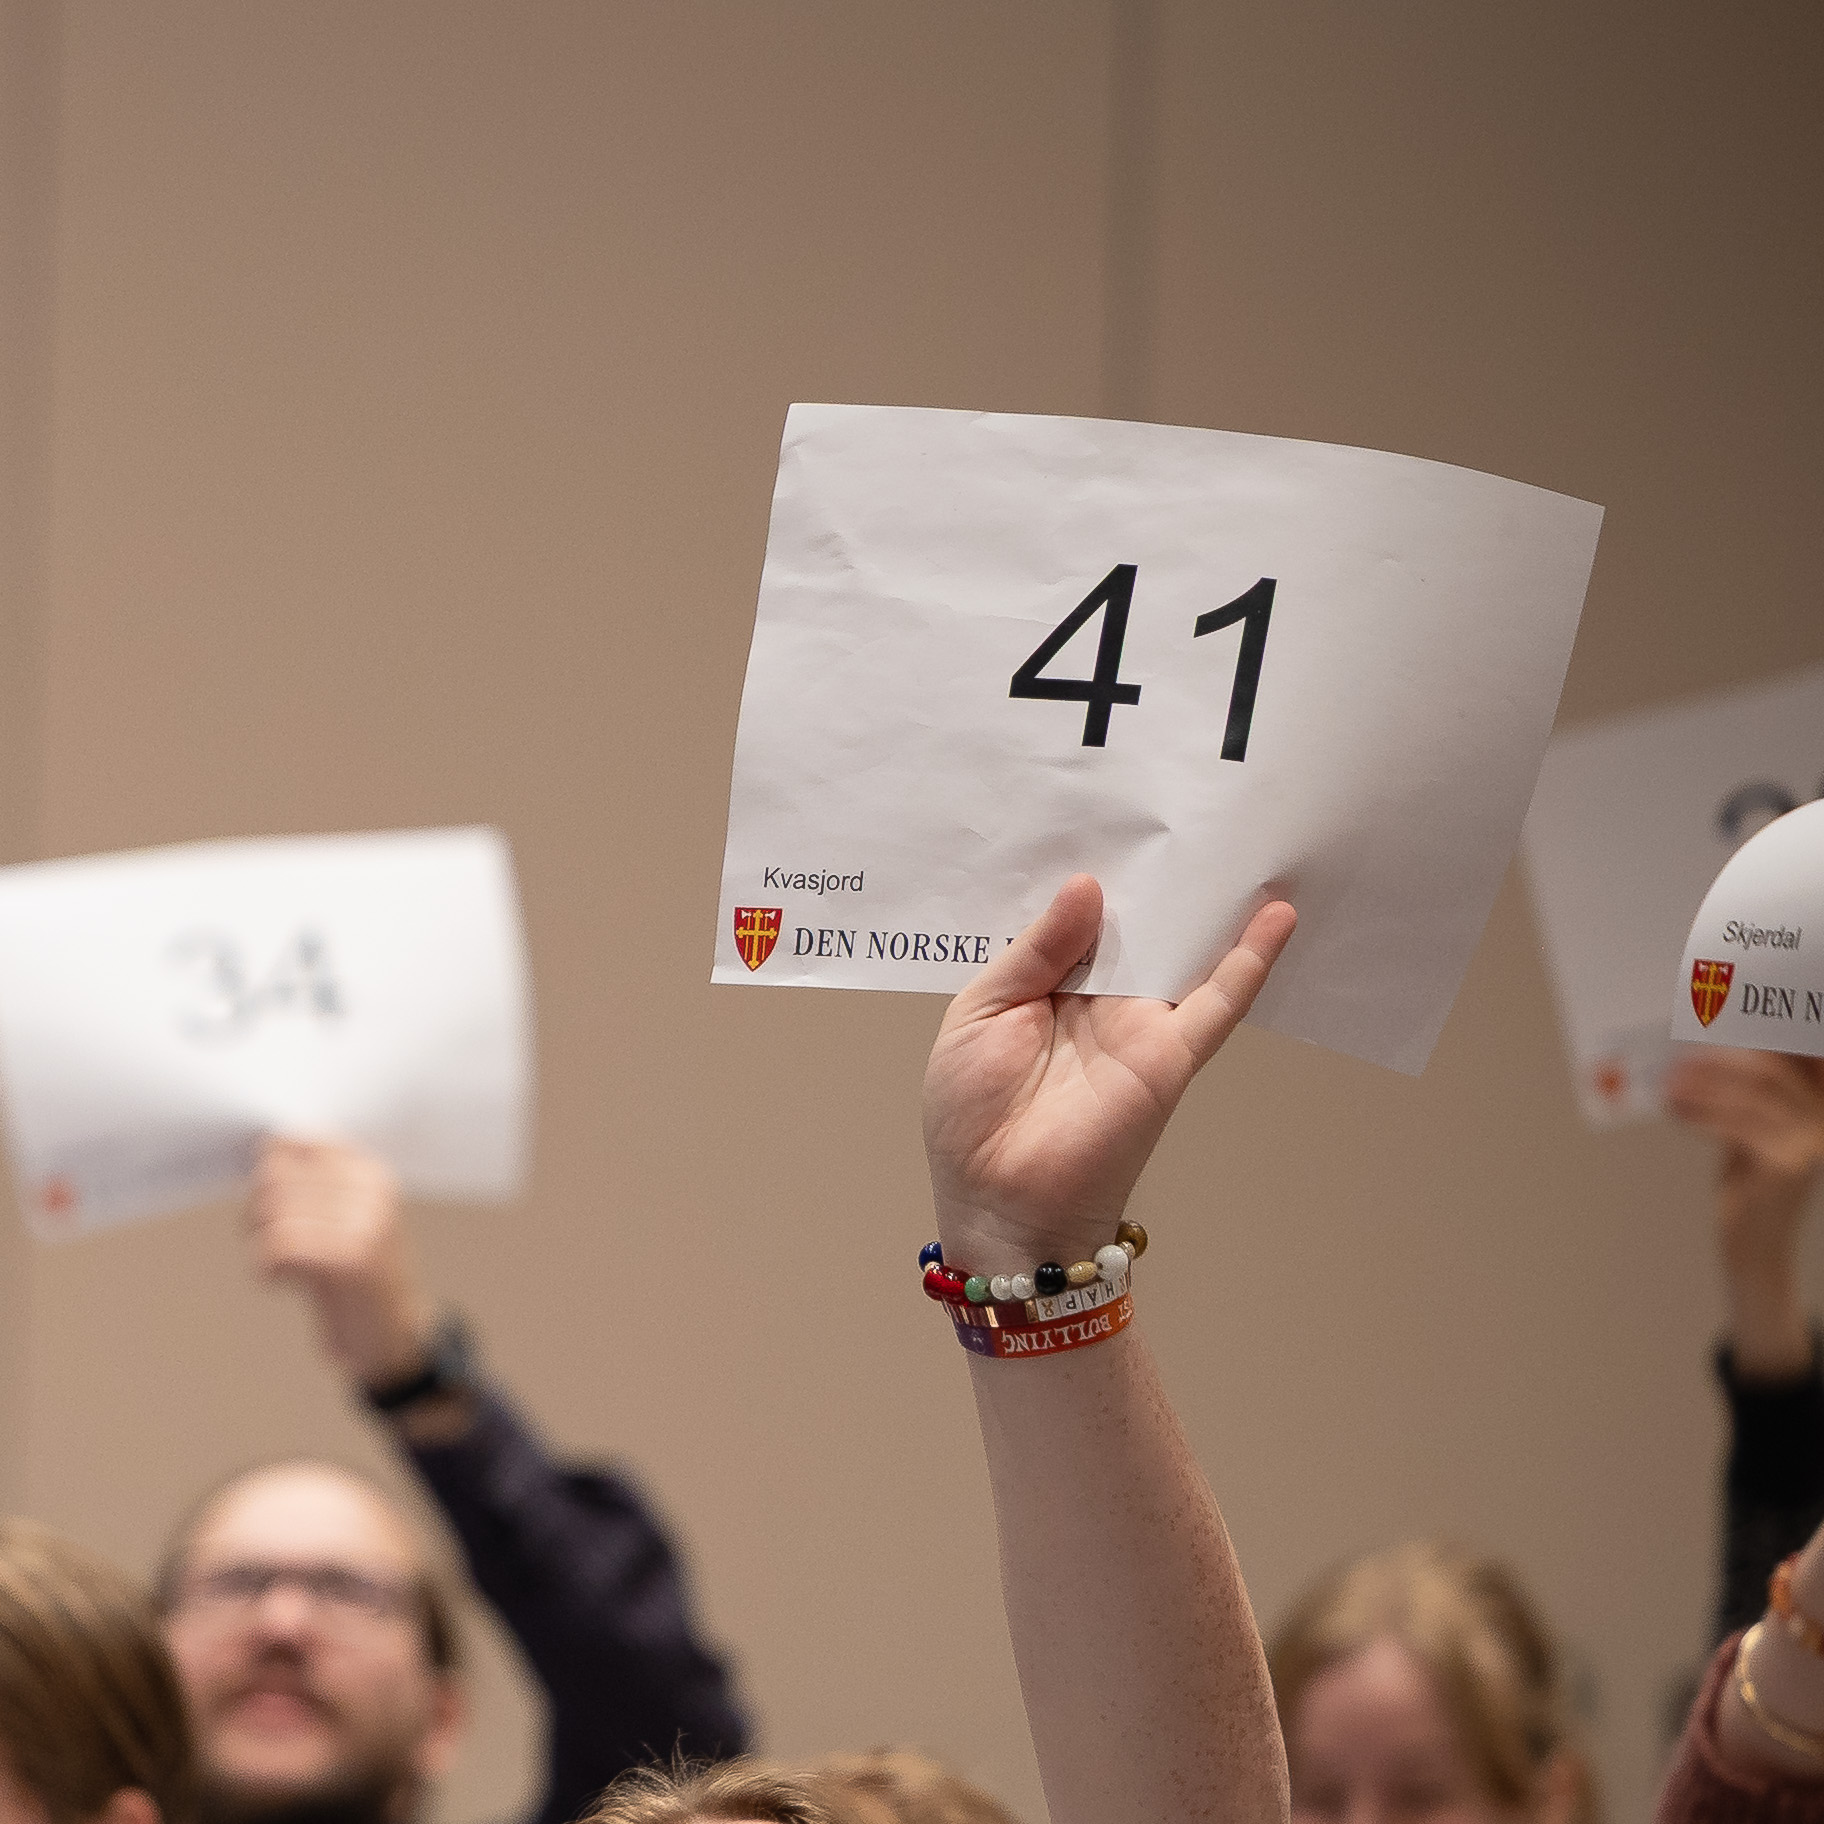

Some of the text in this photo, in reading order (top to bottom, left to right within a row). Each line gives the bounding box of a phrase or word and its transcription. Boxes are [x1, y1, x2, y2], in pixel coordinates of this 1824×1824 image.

[1008, 563, 1277, 763] 41
[762, 866, 865, 896] Kvasjord
[792, 927, 857, 959] DEN
[865, 931, 991, 965] NORSKE
[1722, 920, 1804, 951] Skjerdal
[164, 925, 348, 1050] 34
[1739, 982, 1796, 1020] DEN
